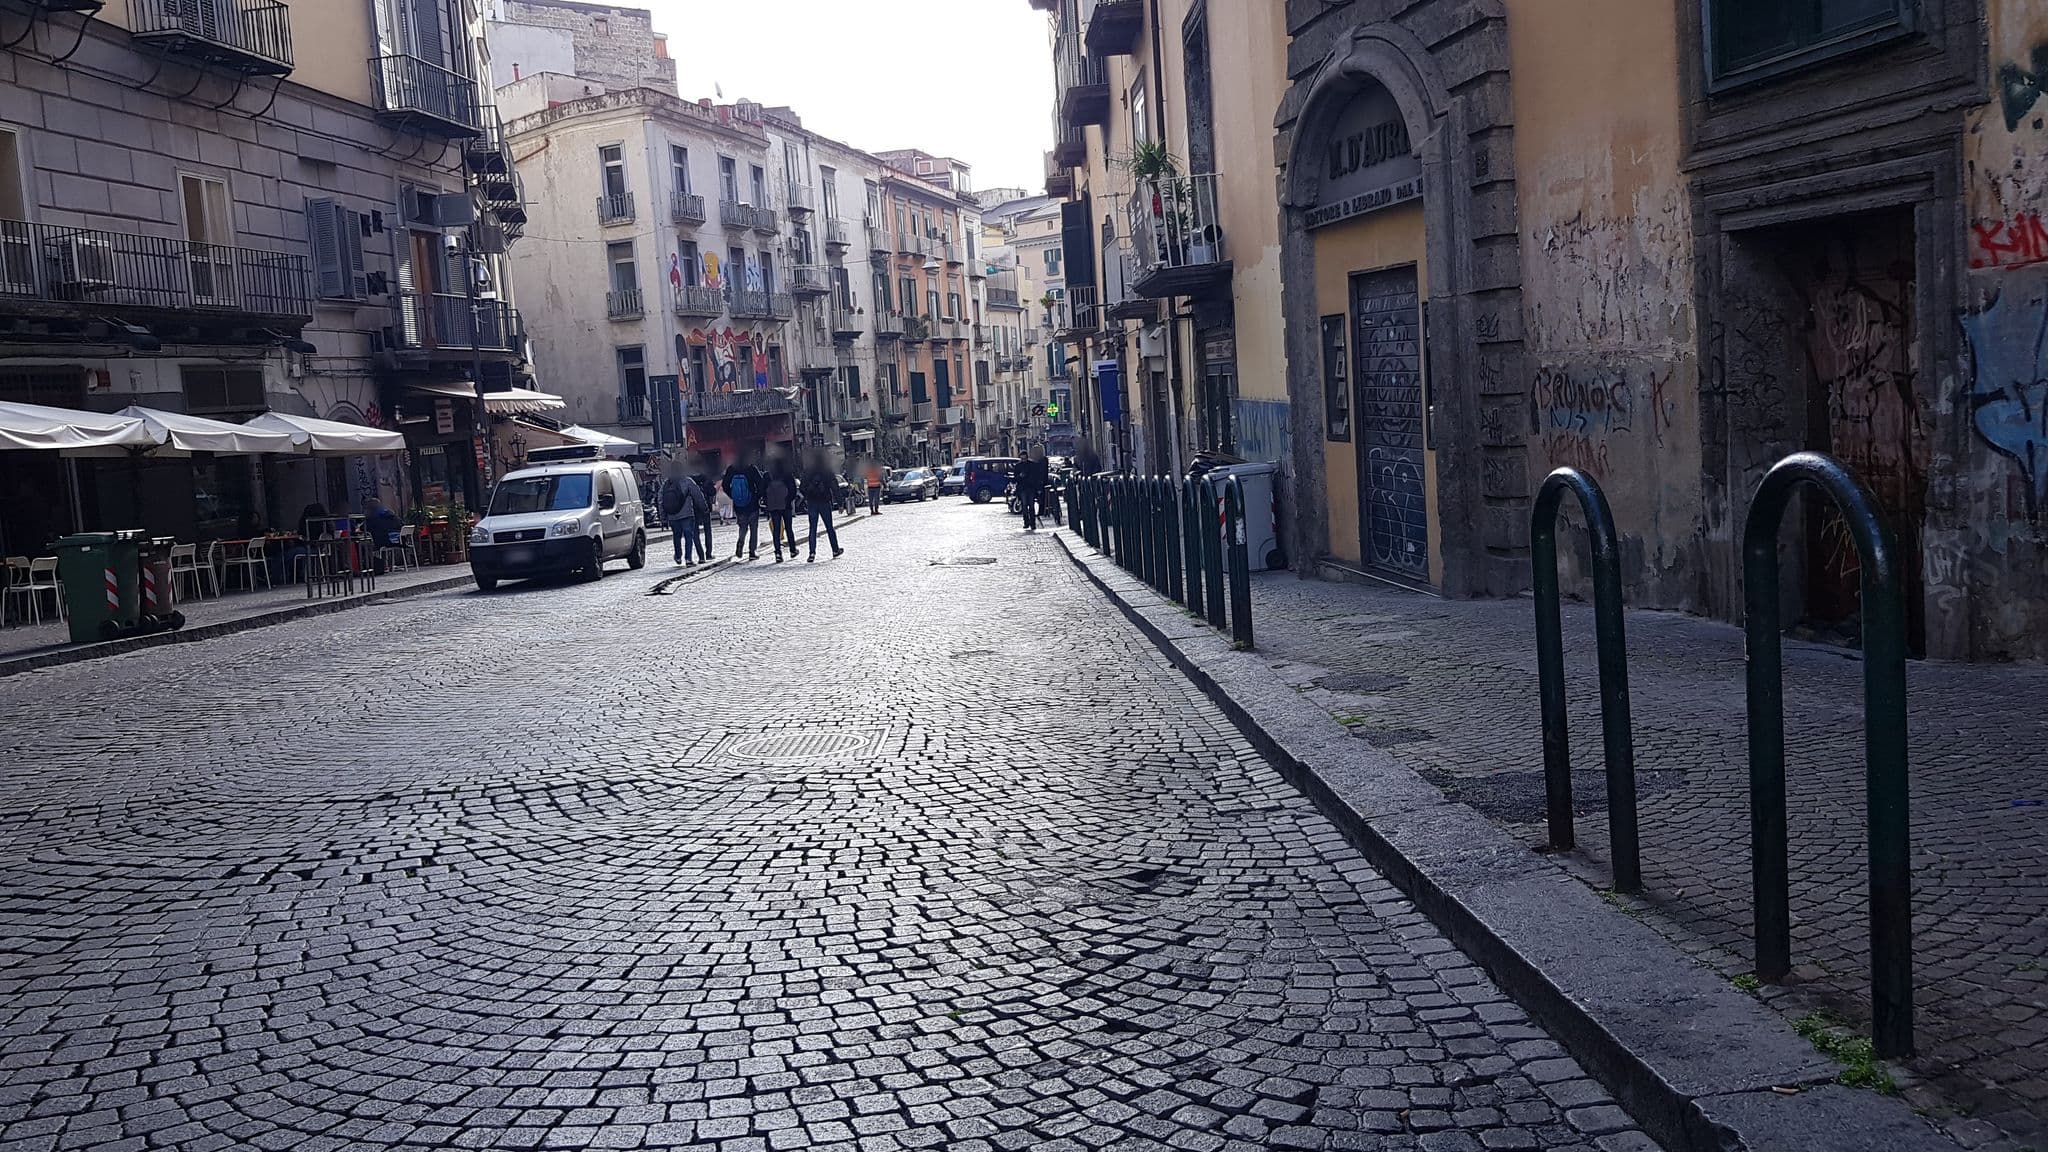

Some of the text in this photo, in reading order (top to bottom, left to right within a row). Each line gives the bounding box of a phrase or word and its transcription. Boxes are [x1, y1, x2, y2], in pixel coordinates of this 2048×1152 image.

[1328, 121, 1411, 179] M.D'AURI
[1352, 188, 1392, 213] LIBRAIO
[1396, 183, 1413, 199] DAL
